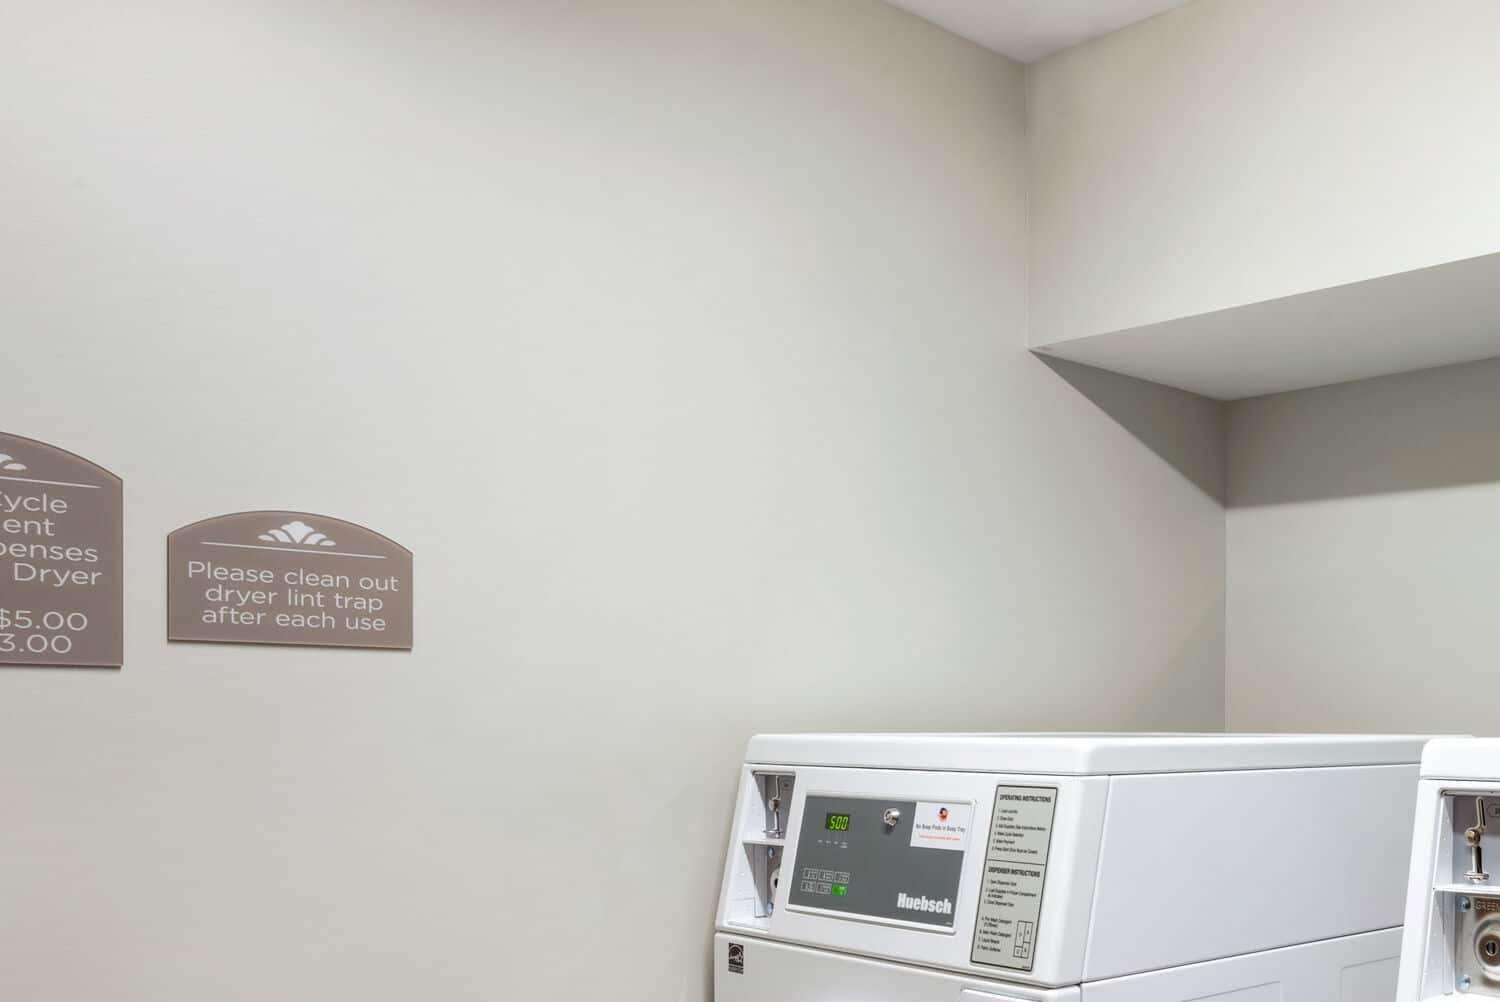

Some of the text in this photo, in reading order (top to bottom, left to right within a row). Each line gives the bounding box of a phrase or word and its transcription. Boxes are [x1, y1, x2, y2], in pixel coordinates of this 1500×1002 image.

[0, 492, 68, 514] ycle
[14, 562, 102, 587] Dryer
[187, 561, 399, 592] Please clean out
[205, 584, 383, 613] dryer lint trap
[0, 608, 88, 631] $5.00
[202, 606, 387, 631] after each use
[829, 815, 849, 831] 500
[897, 892, 952, 914] Huebsch
